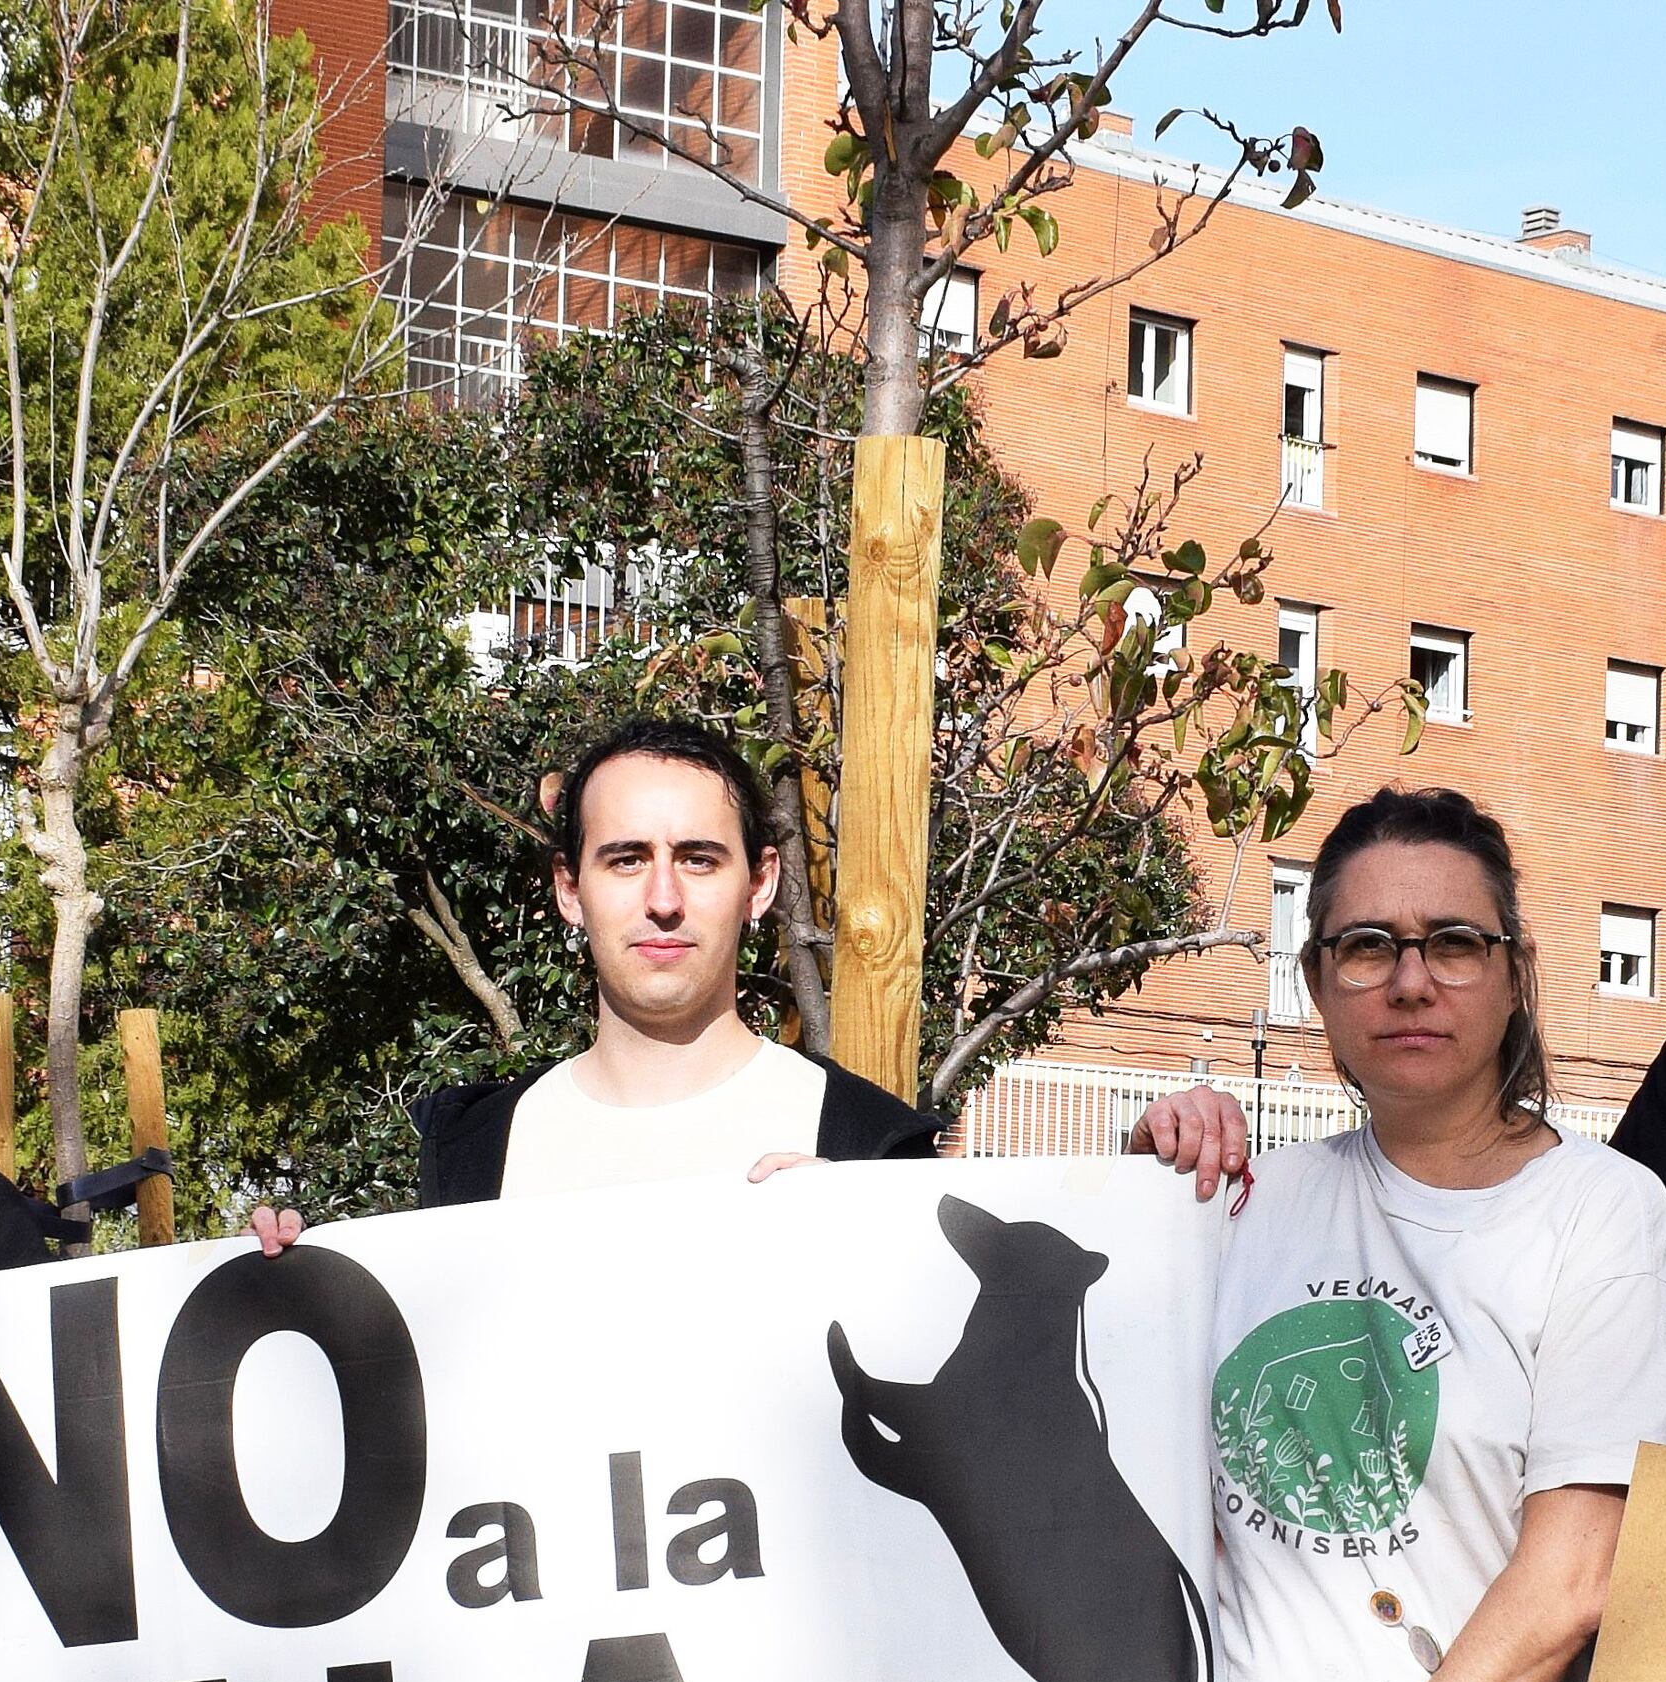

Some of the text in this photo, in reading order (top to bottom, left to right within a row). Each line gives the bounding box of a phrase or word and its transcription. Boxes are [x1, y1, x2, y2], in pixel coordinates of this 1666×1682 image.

[444, 1448, 766, 1610] a la
[1214, 1472, 1420, 1559] CORNISERAS
